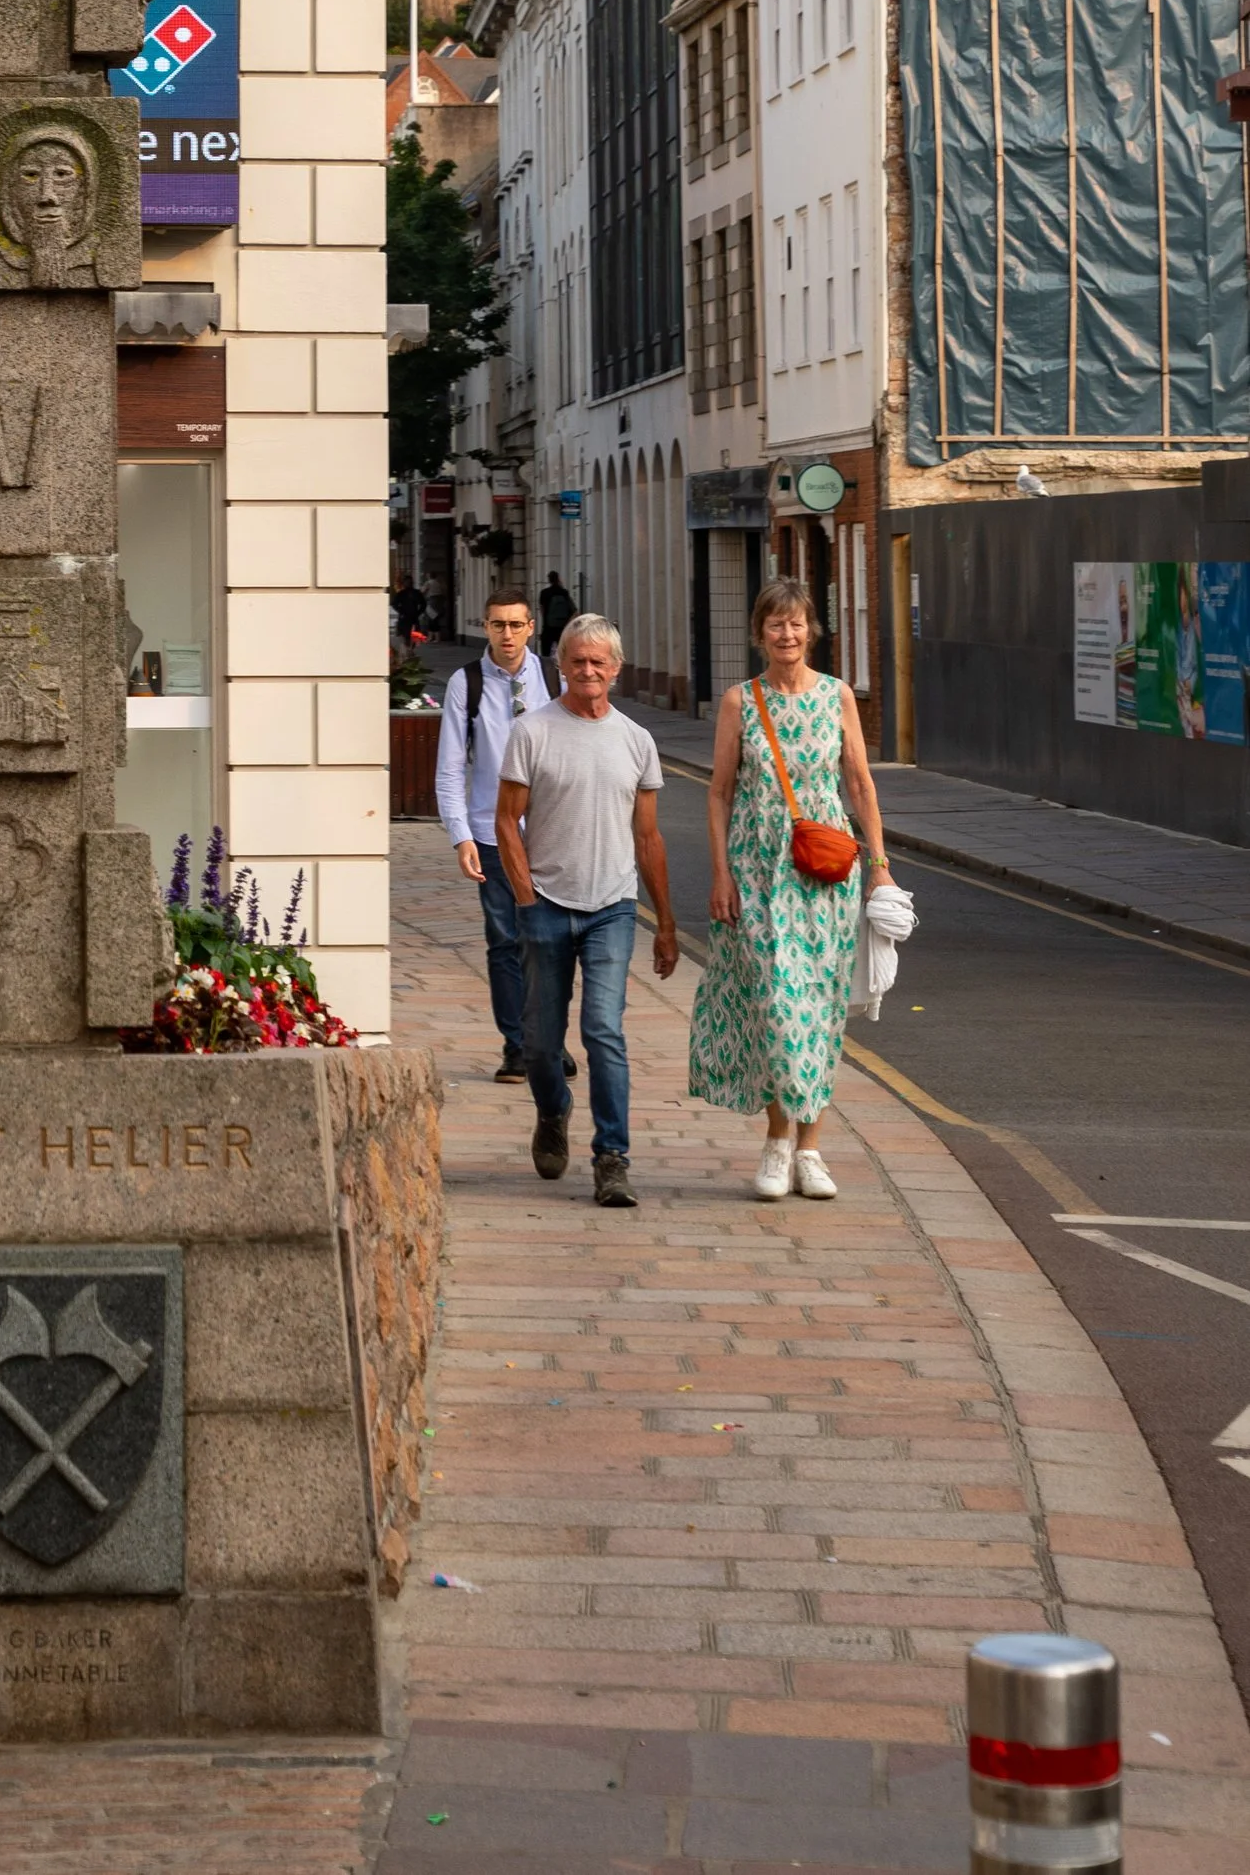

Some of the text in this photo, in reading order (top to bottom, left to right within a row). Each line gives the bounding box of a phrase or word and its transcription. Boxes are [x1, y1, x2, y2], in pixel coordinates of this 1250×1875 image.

[175, 423, 223, 432] TEMPORARY
[189, 434, 210, 442] SIGN
[39, 1123, 256, 1172] HELIER
